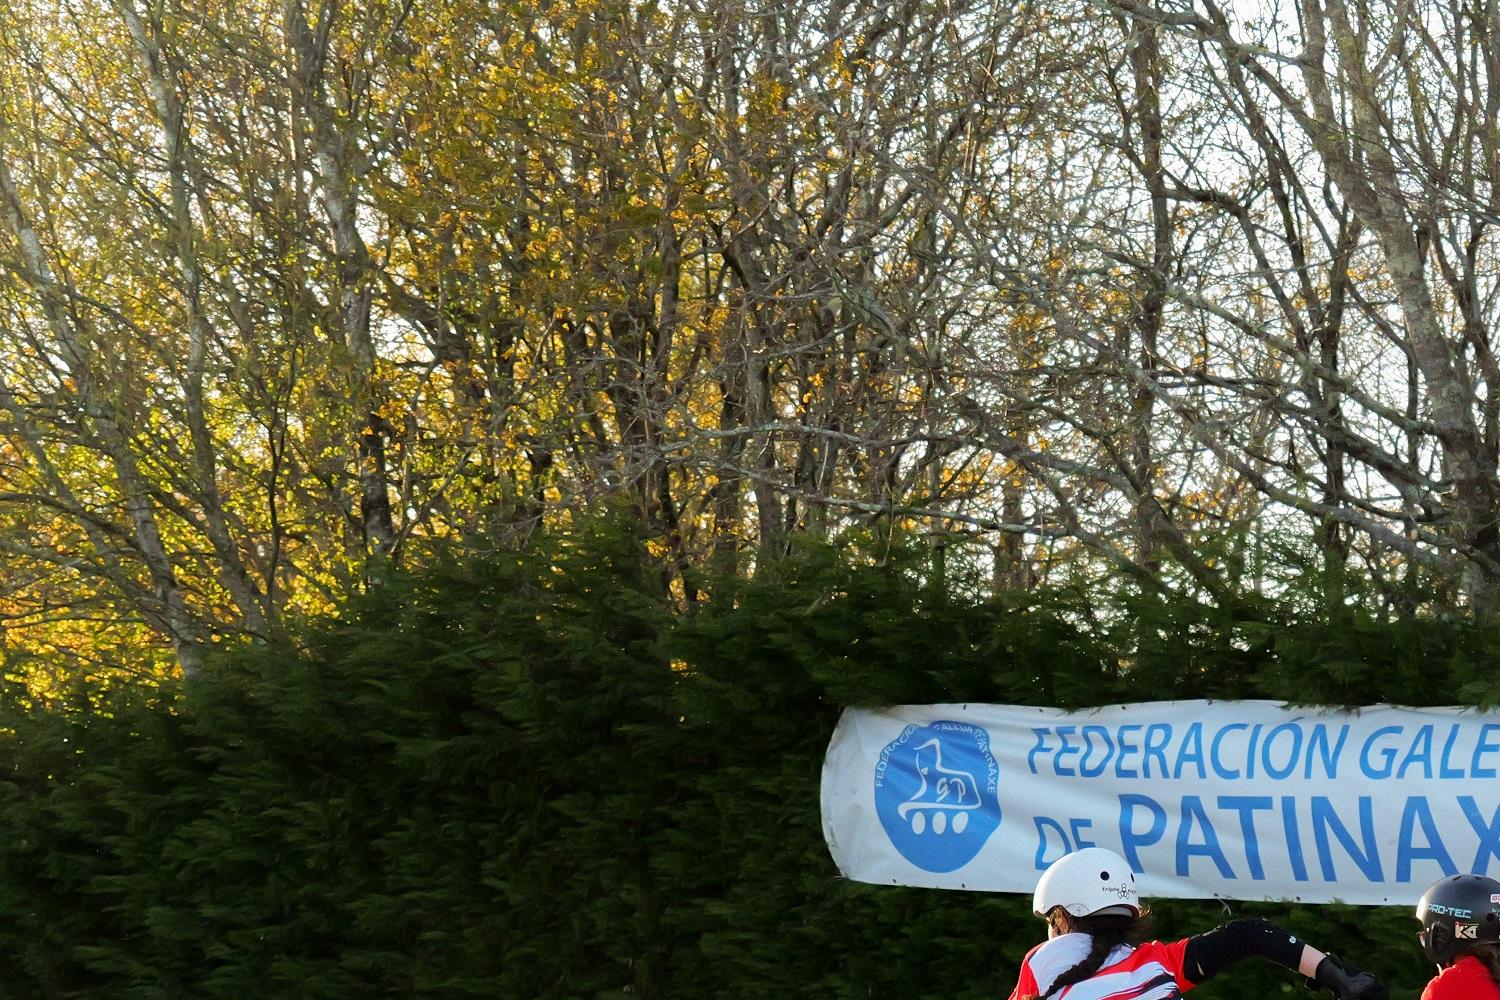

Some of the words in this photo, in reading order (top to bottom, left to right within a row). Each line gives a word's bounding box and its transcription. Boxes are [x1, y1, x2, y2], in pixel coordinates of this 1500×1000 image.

[1028, 715, 1351, 781] FEDERACIÓN
[1032, 815, 1097, 871] DE
[1426, 903, 1473, 919] PRO-TEC
